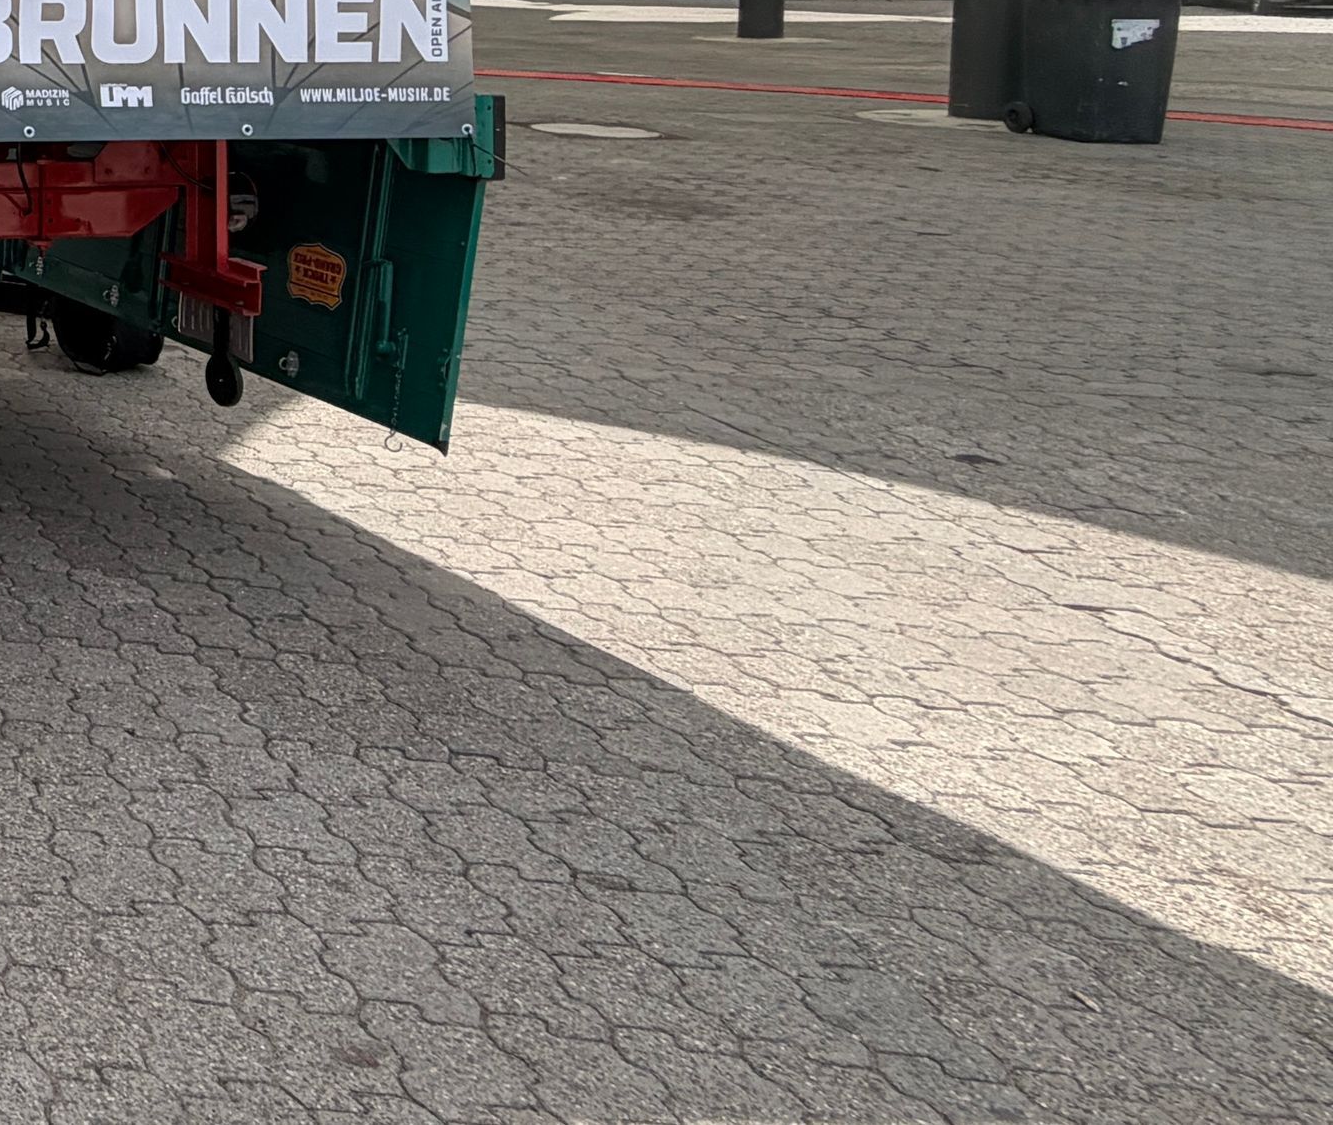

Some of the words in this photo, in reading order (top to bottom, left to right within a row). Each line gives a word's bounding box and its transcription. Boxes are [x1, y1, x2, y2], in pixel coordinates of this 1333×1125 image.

[431, 18, 443, 57] OPEN
[26, 88, 70, 99] MADIZIN
[180, 86, 224, 105] Gaffel
[226, 86, 274, 106] Kölsch
[300, 87, 451, 103] WWW.MILJOE-MUSIK.DE
